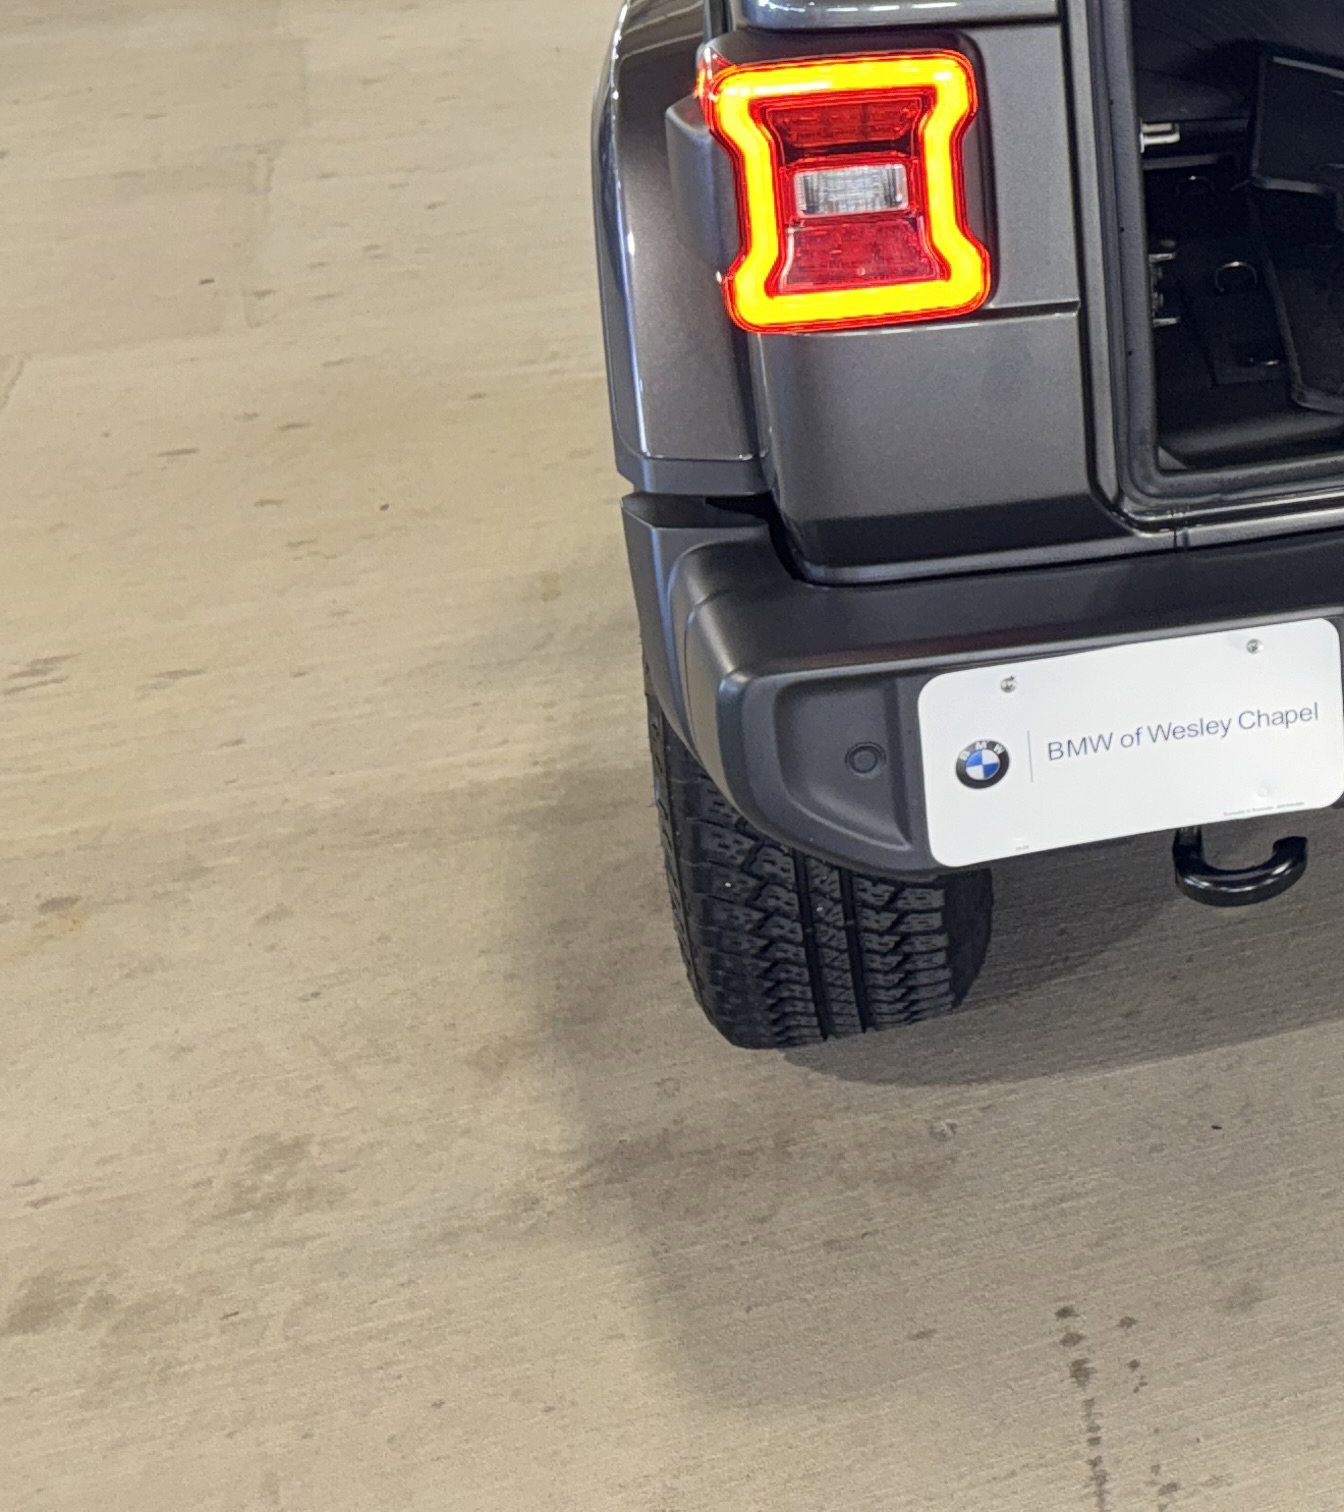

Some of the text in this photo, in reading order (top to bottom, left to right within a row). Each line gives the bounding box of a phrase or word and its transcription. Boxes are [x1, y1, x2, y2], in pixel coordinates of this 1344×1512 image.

[1047, 702, 1319, 761] BMW of Wesley Chapel
